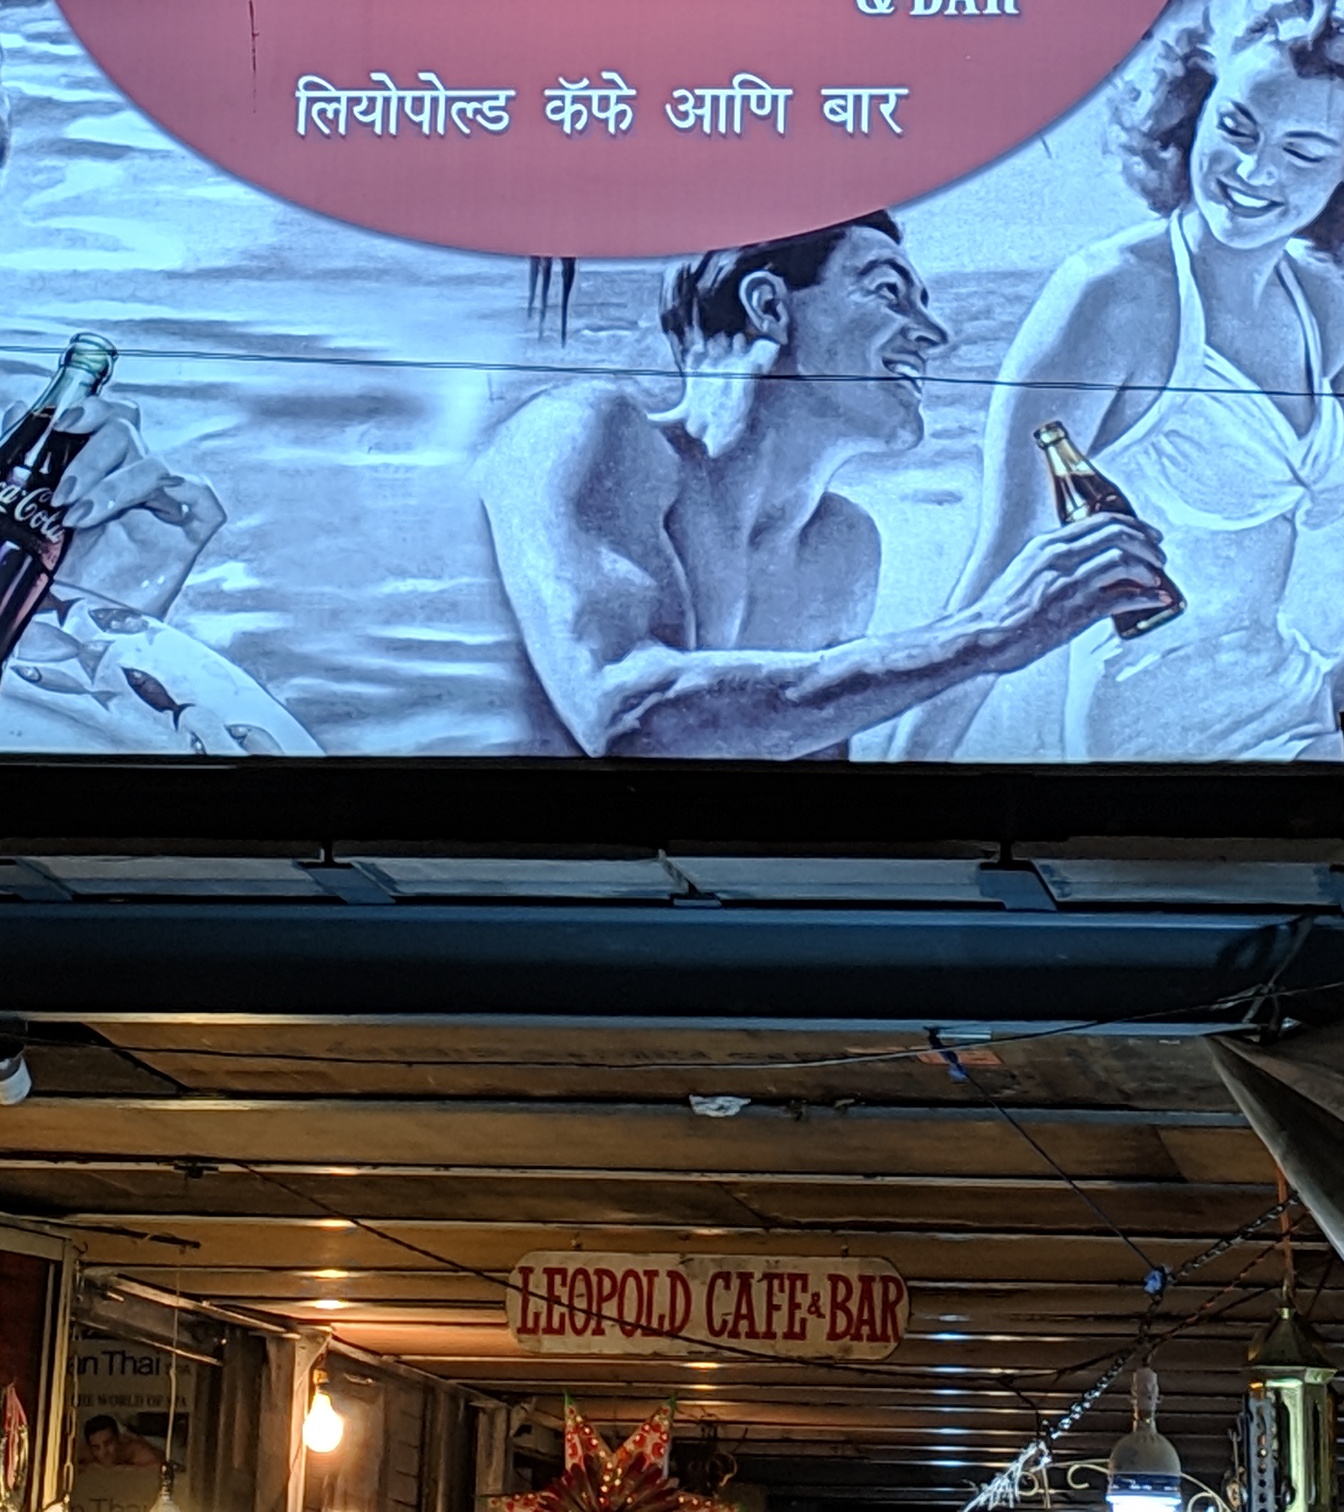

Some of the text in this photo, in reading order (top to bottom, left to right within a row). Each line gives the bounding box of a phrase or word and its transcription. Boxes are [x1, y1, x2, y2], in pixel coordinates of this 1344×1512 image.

[295, 71, 909, 136] लियोपोल्ड कॅफे आणि बार
[516, 1265, 693, 1339] LEOPOLD
[101, 1349, 161, 1376] Thai
